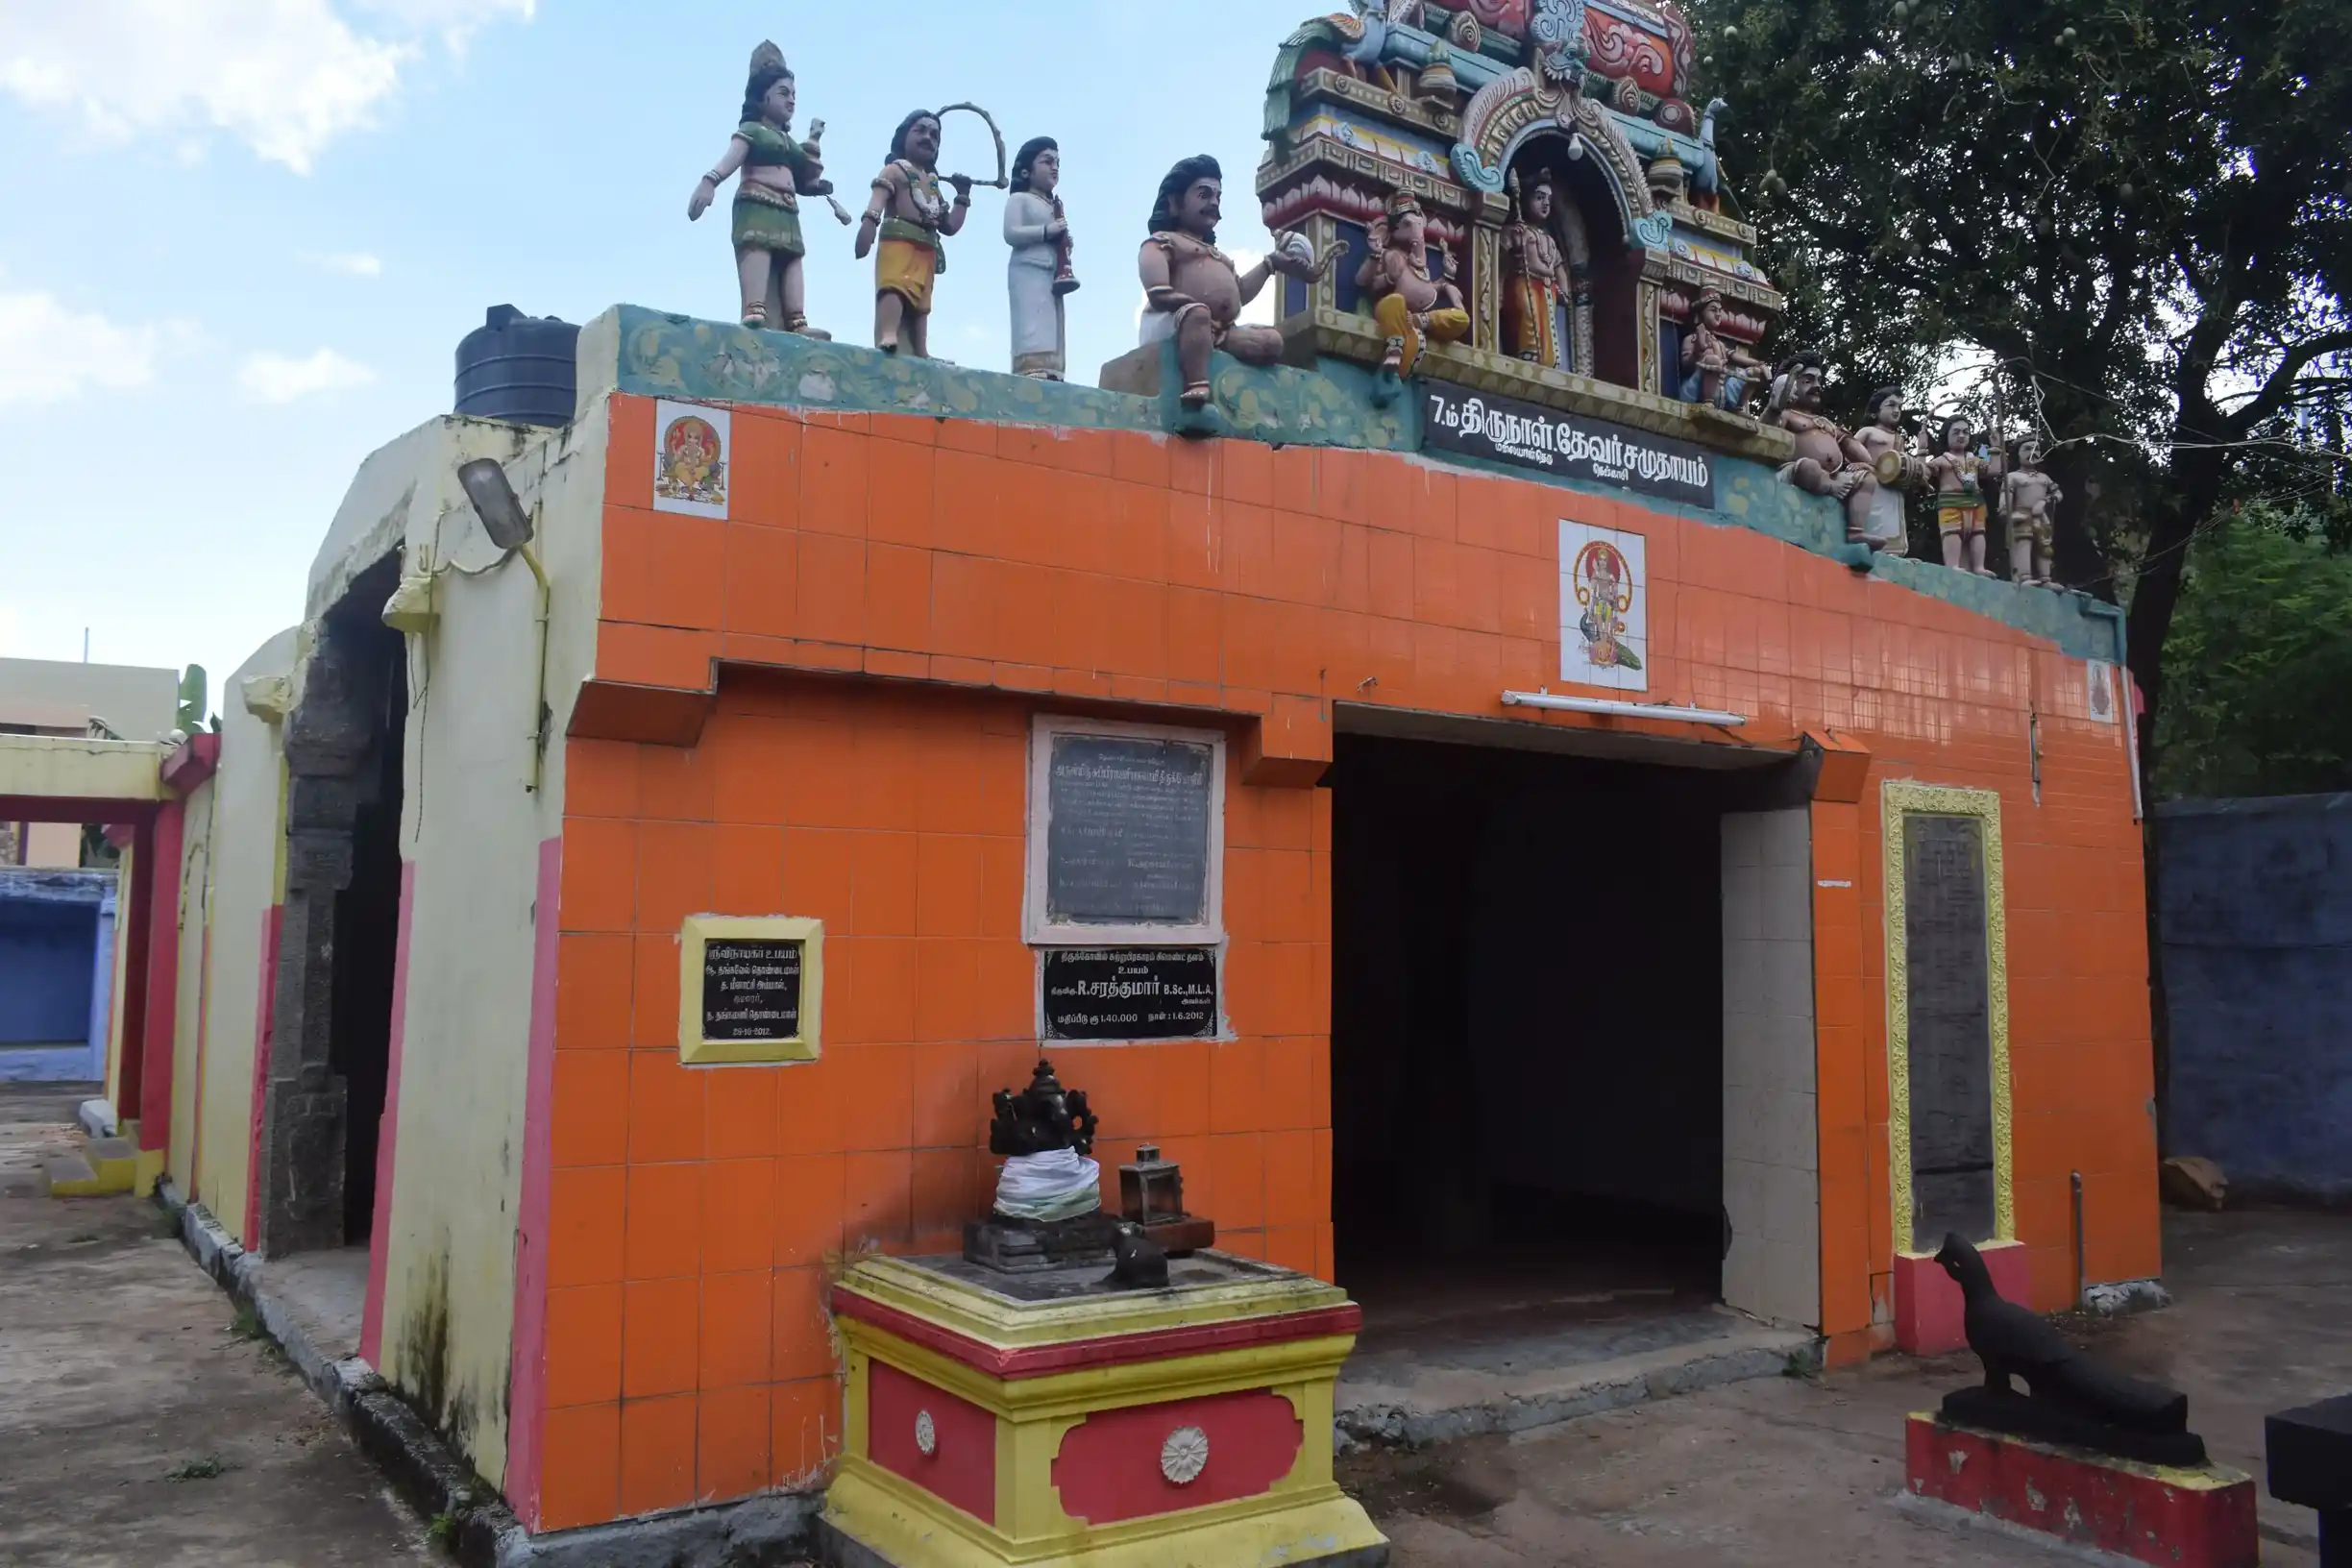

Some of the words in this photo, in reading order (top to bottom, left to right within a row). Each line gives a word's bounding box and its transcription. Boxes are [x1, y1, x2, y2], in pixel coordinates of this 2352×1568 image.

[1556, 422, 1624, 467] தேவர்
[1624, 443, 1709, 489] சமுதாயம்
[765, 945, 798, 960] உபயம்
[1117, 964, 1149, 975] உபயம்
